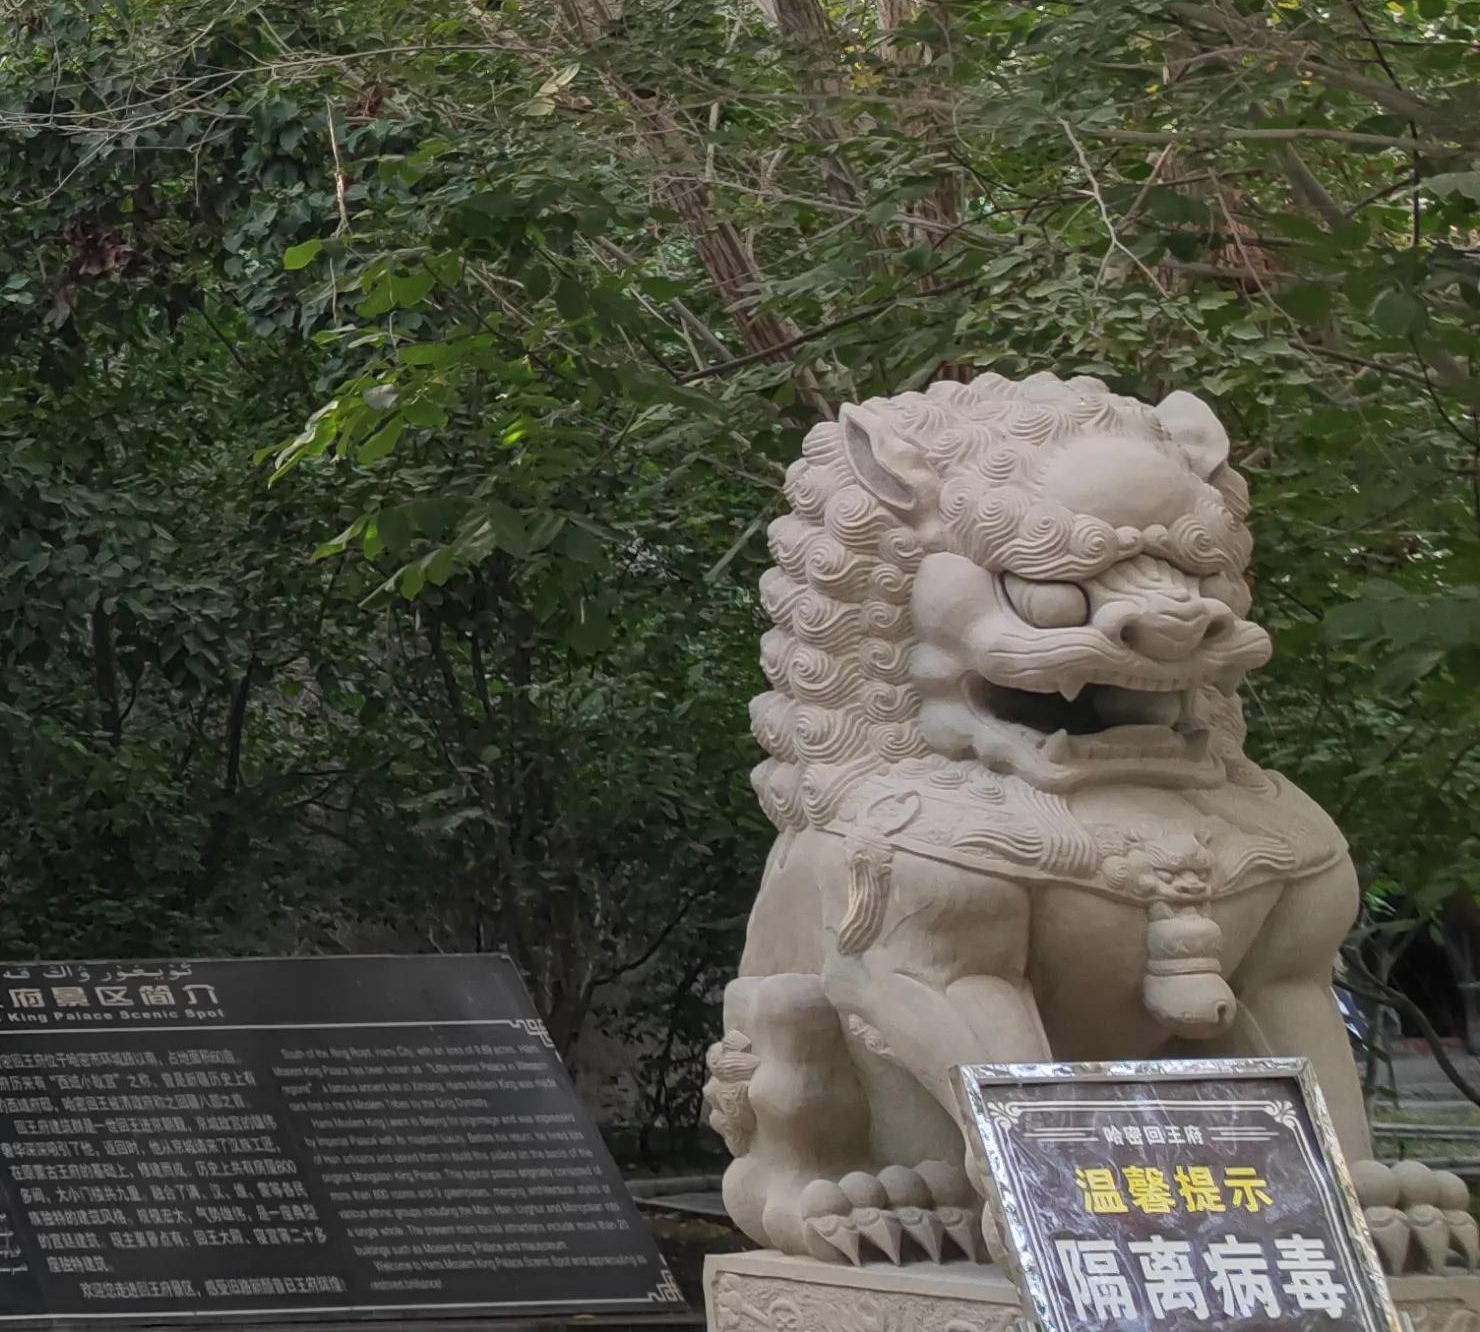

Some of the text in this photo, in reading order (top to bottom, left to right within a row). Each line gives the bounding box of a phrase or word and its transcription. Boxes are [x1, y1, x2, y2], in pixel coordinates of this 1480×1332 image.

[7, 1011, 48, 1024] King
[54, 1010, 114, 1022] Palace
[119, 1009, 179, 1021] Scenic
[185, 1008, 225, 1021] Spot
[1103, 1125, 1205, 1146] 哈密回王府
[1074, 1165, 1273, 1214] 温馨提示
[1055, 1233, 1346, 1320] 隔离病毒
